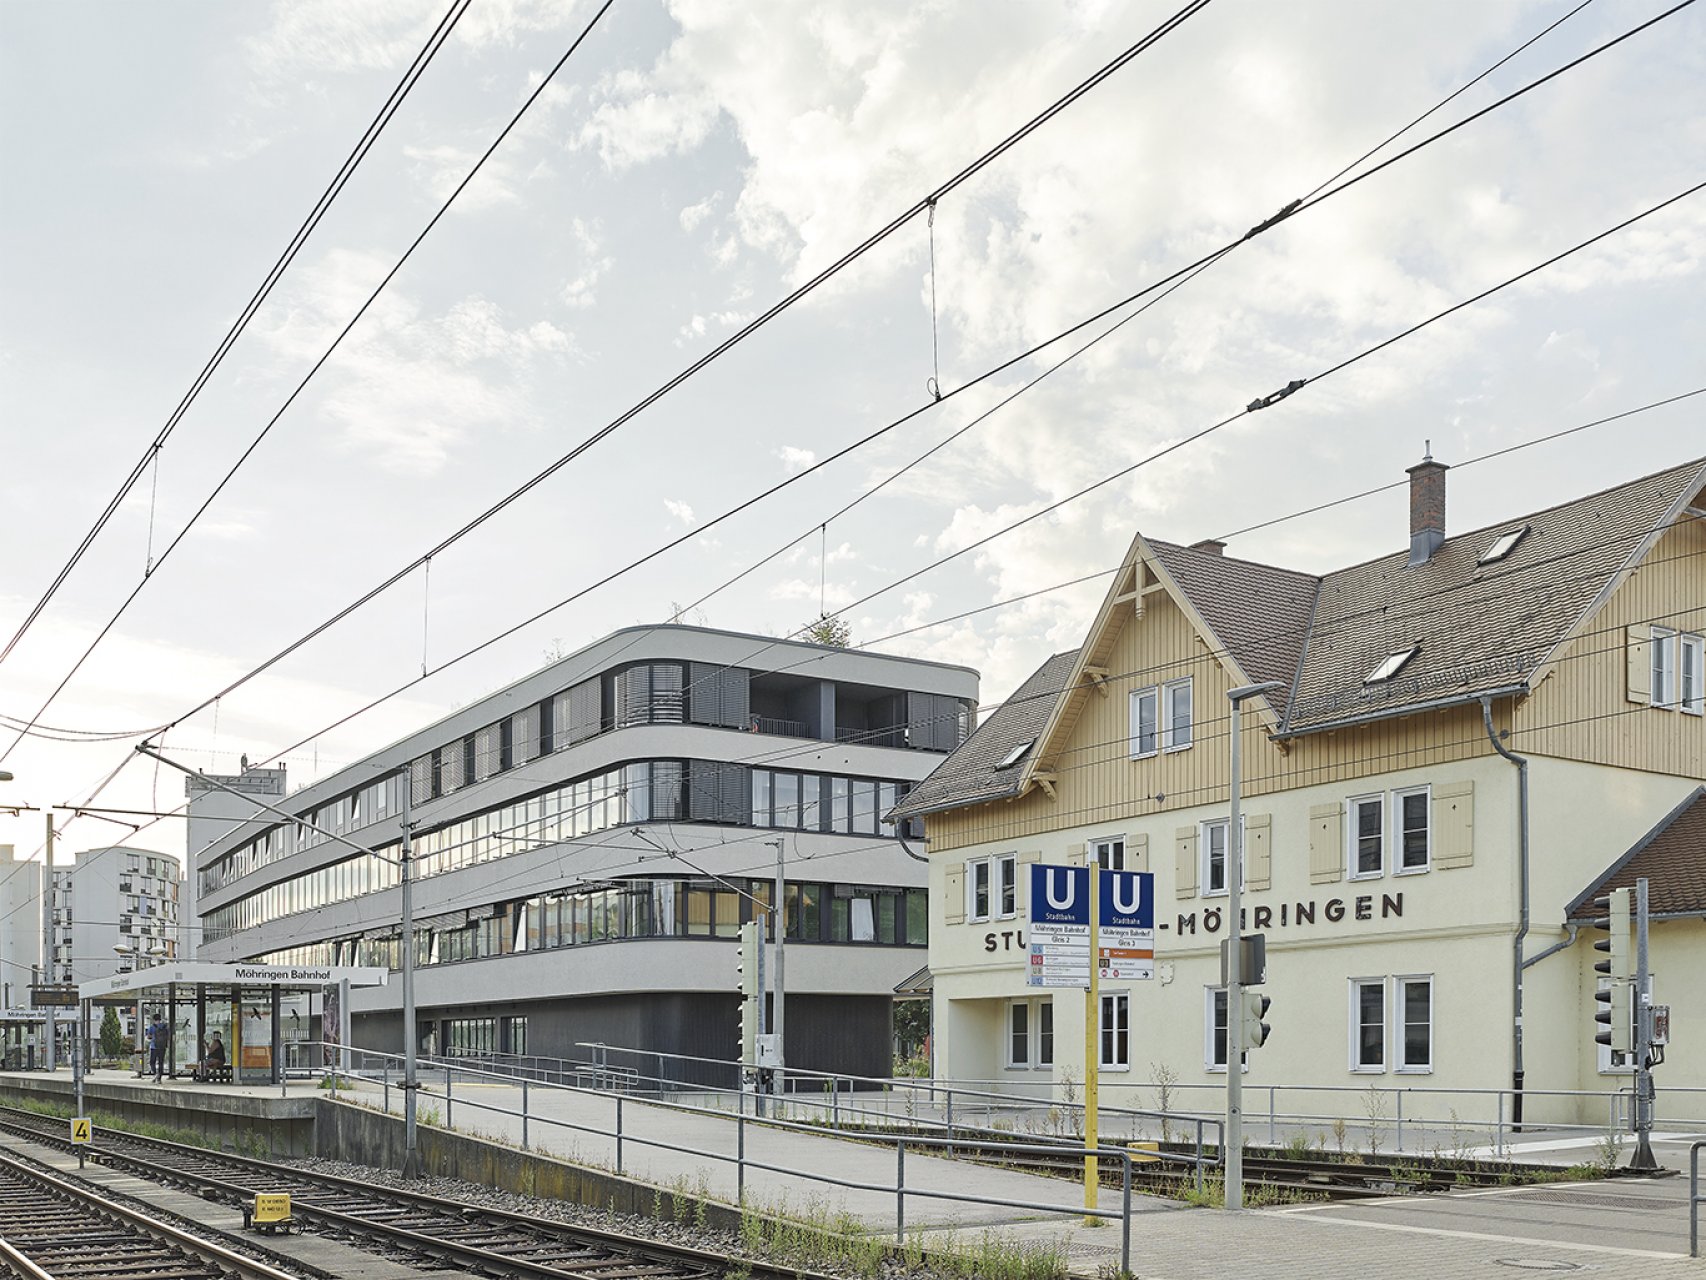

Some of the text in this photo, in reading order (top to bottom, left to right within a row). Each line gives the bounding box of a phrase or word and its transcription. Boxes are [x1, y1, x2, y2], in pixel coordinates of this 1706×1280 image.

[1046, 868, 1075, 910] U
[1113, 873, 1140, 915] U
[1045, 912, 1075, 921] Stadtbahn
[1112, 916, 1140, 925] Stadtbahn
[1034, 924, 1086, 935] Möhringen Bahnhof
[1102, 928, 1151, 938] Möhringen Bahnhof
[1051, 935, 1065, 944] Gleis
[1118, 939, 1130, 947] Gleis
[1032, 945, 1042, 954] U5
[1032, 956, 1042, 965] U6
[235, 969, 330, 980] Möhringen Bahnhof
[1032, 967, 1042, 975] U8
[75, 1122, 87, 1140] 4
